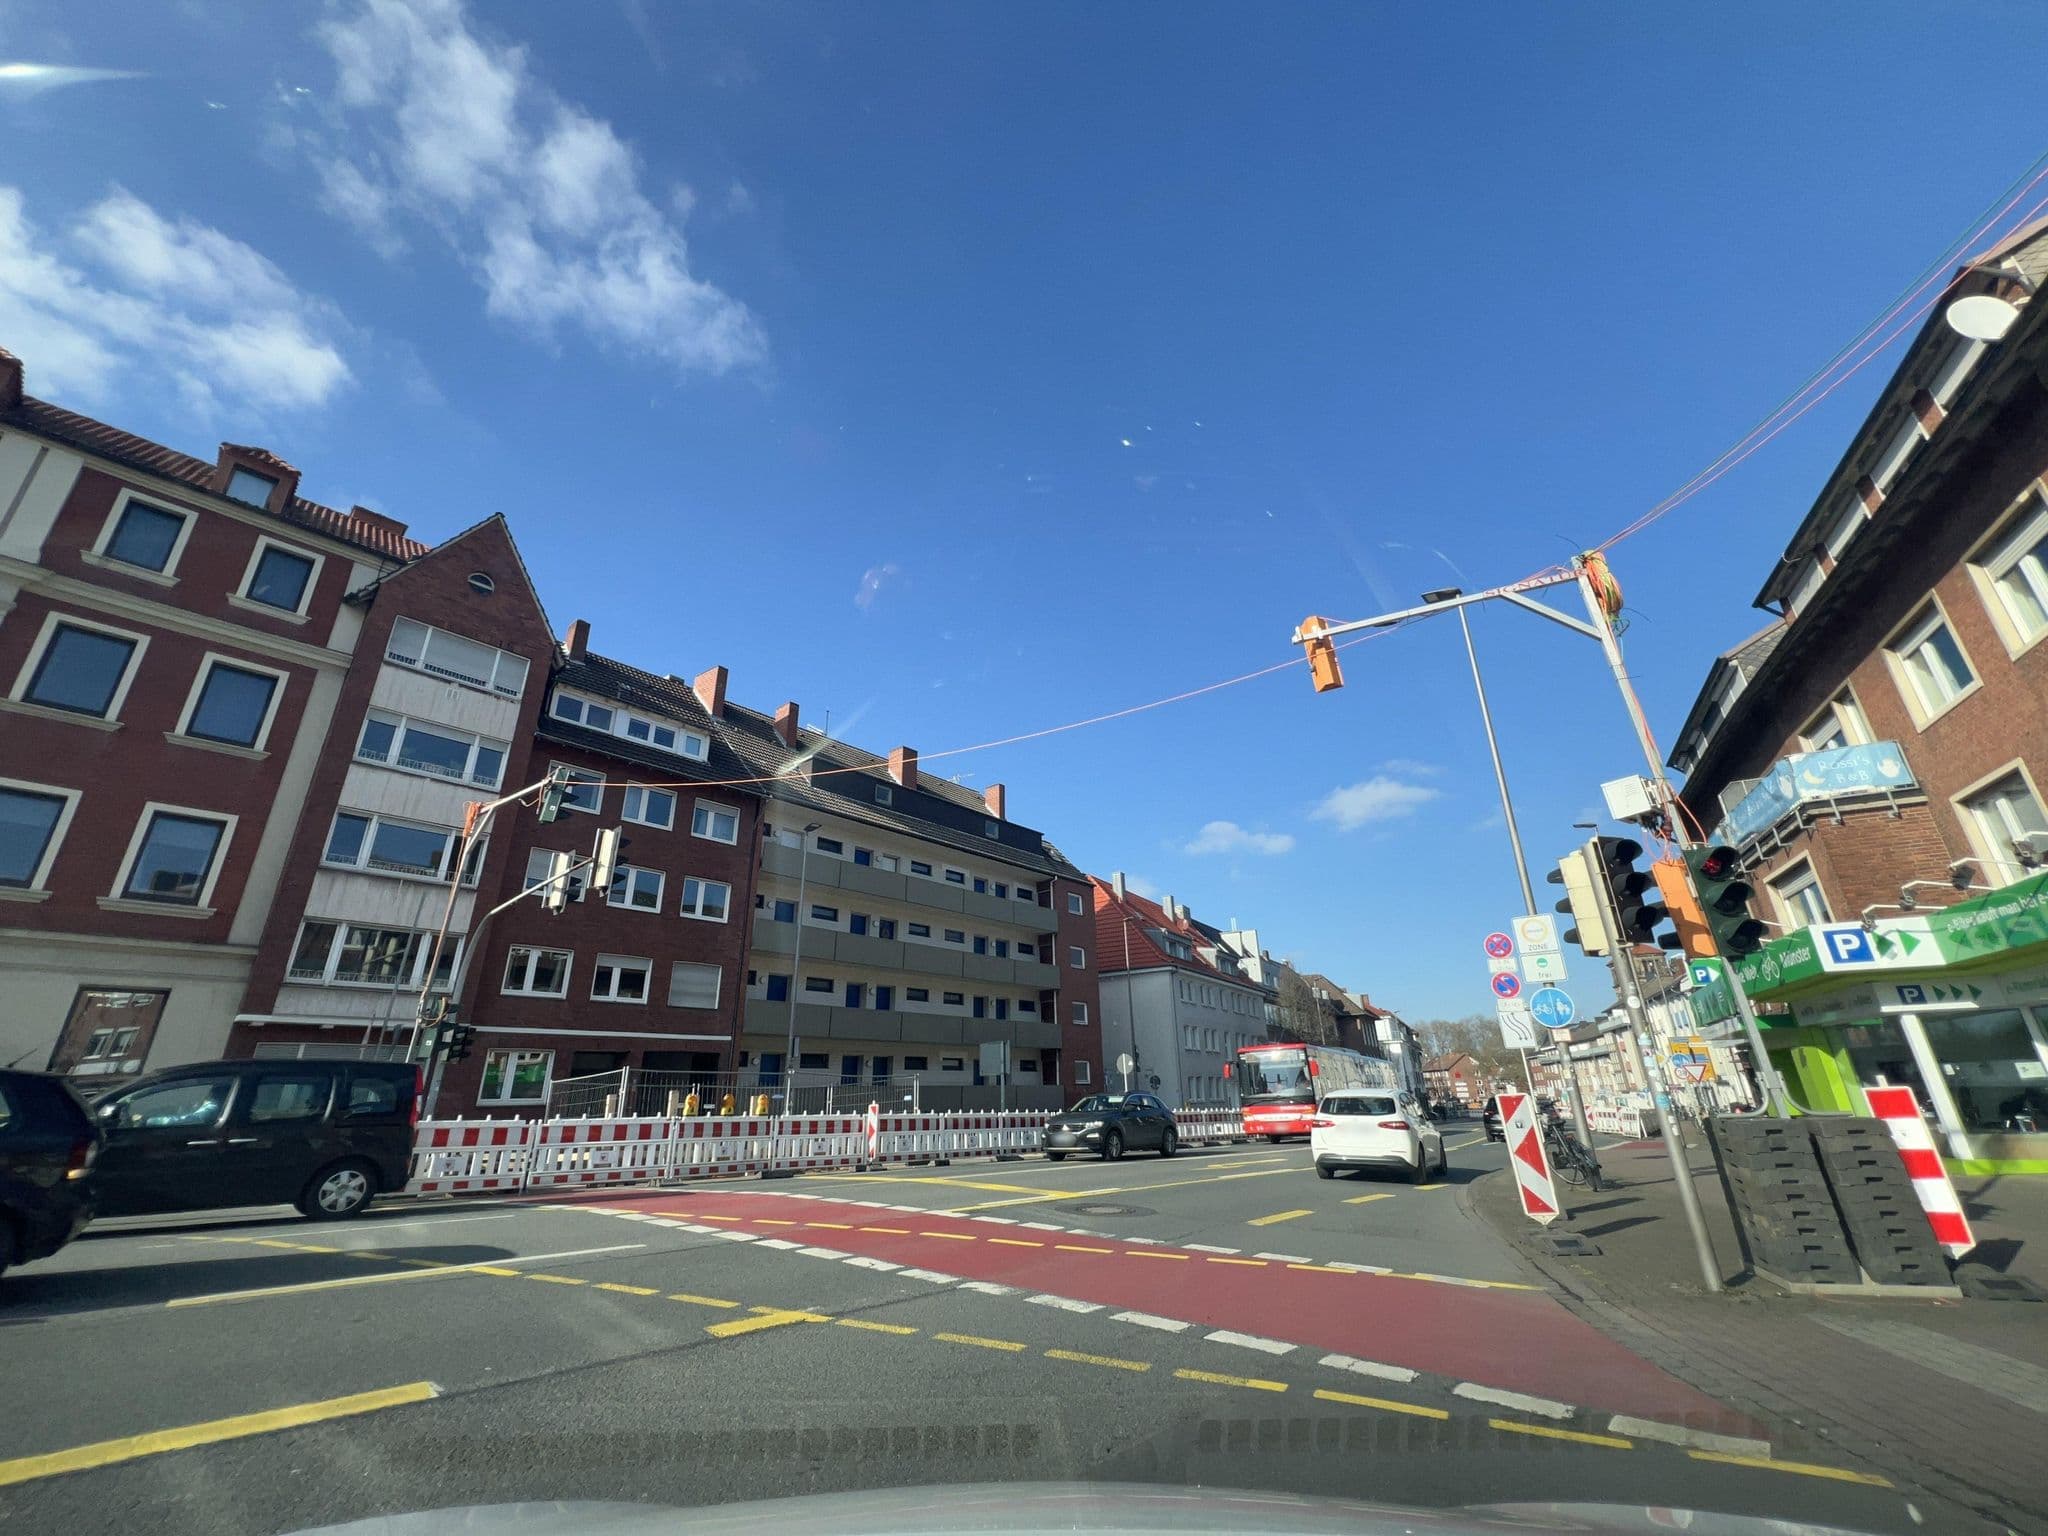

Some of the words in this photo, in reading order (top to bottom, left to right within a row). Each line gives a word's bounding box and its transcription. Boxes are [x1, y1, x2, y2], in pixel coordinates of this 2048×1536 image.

[1527, 943, 1549, 952] ZONE
[1832, 933, 1861, 960] P
[1778, 946, 1812, 969] Münster
[1695, 969, 1707, 982] P
[1902, 988, 1920, 1004] P
